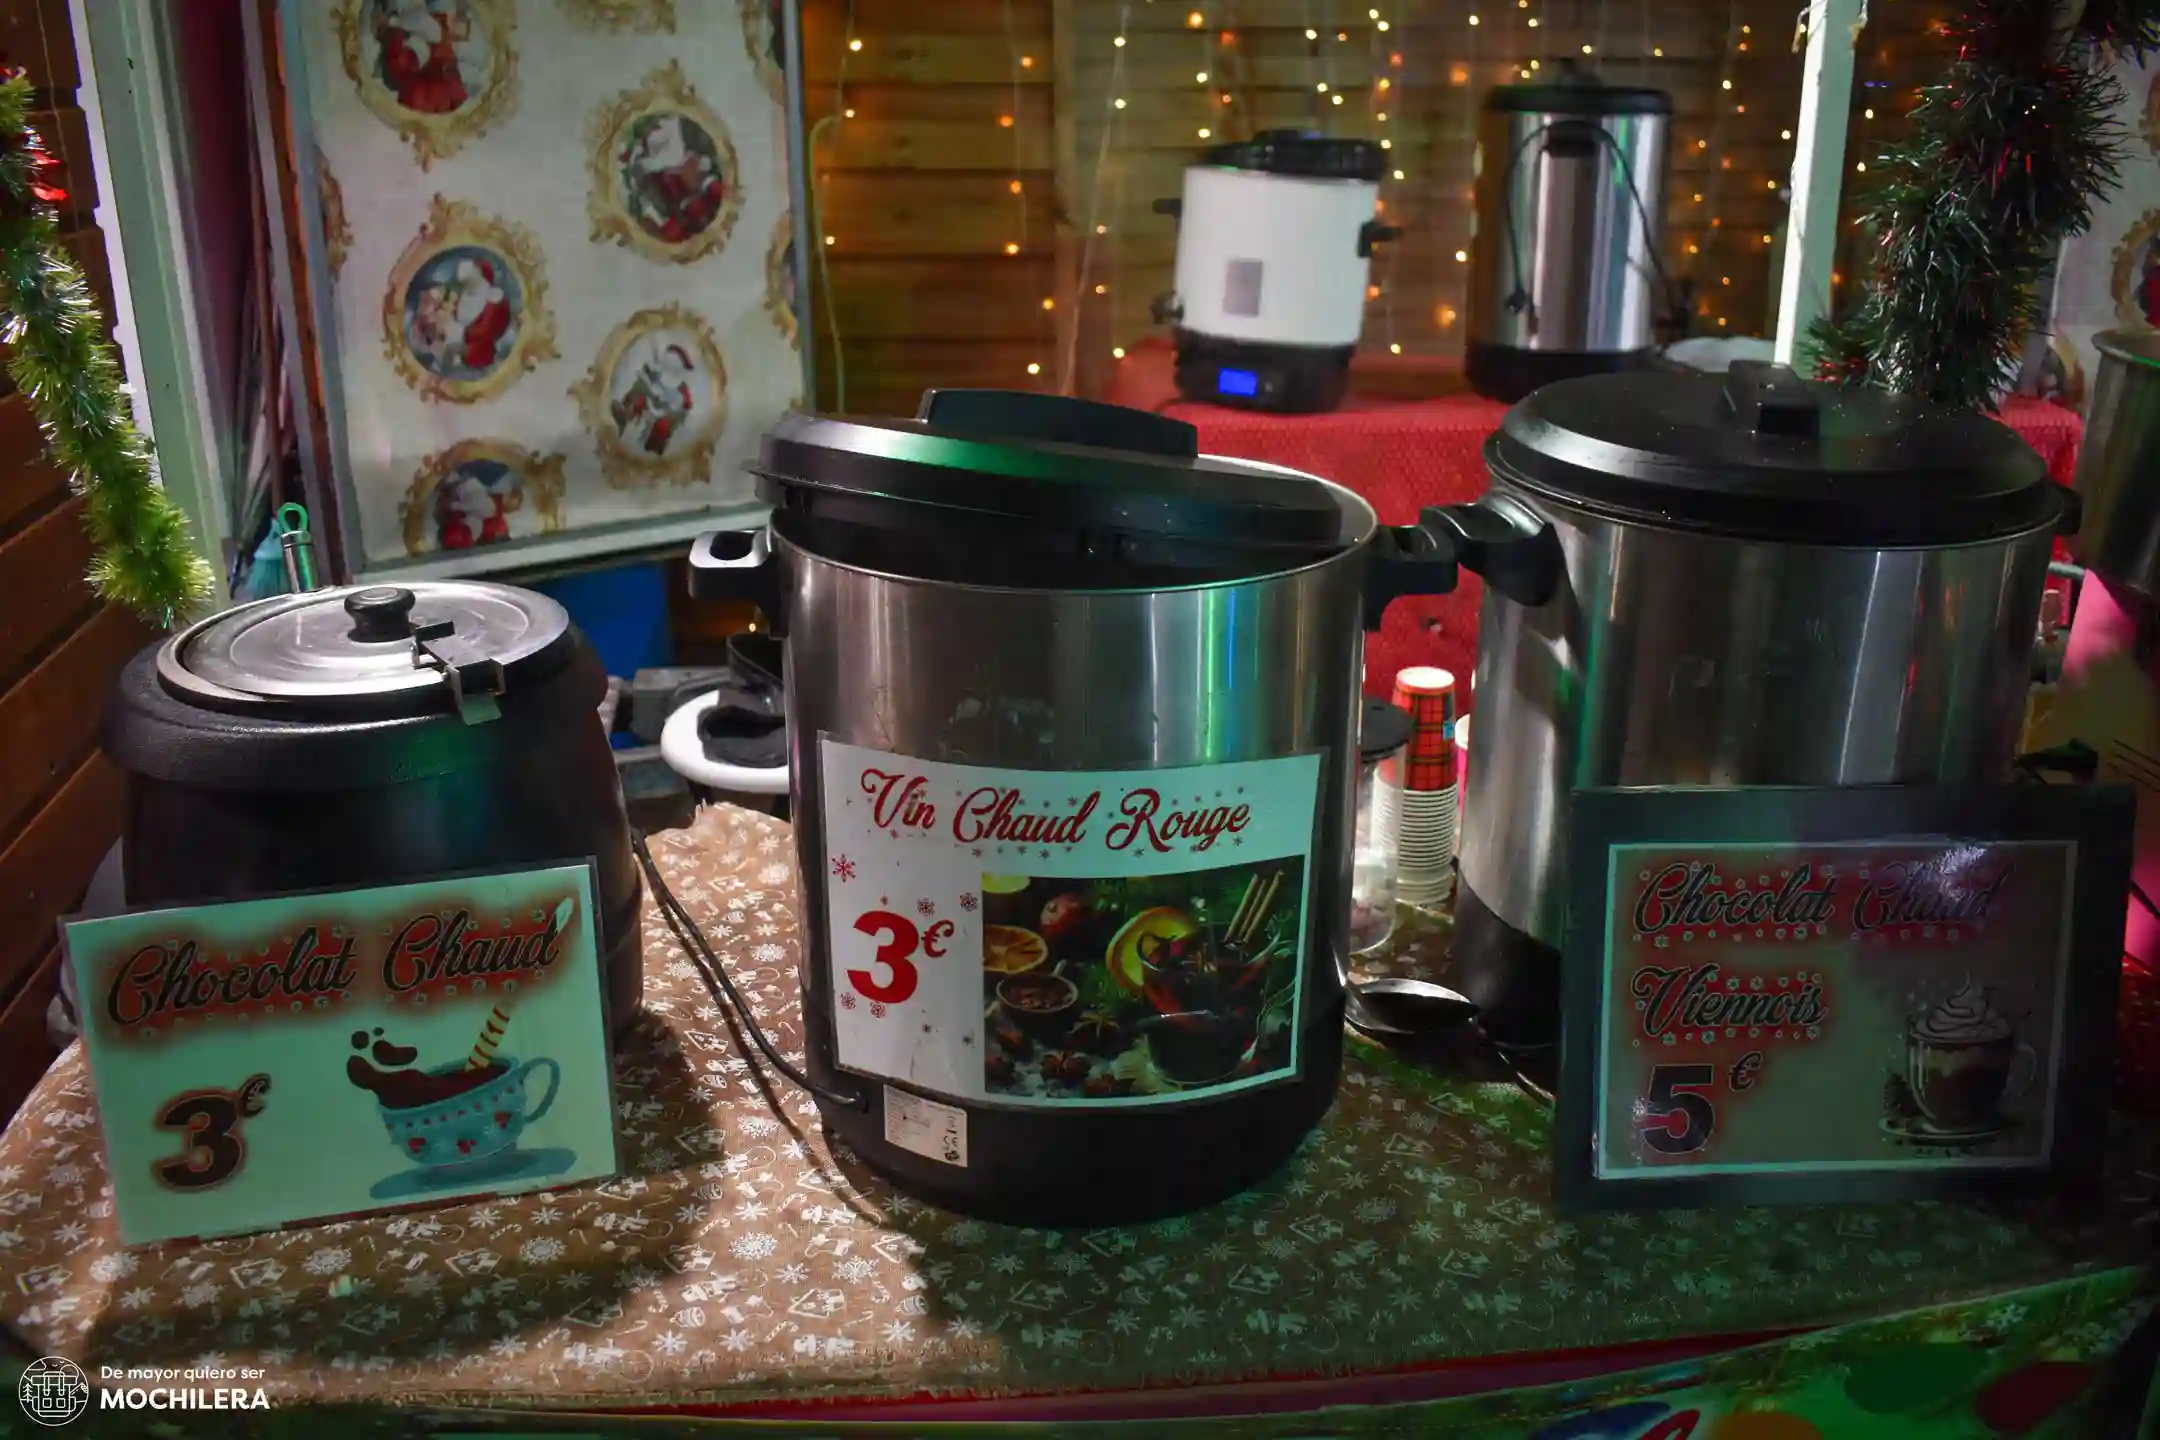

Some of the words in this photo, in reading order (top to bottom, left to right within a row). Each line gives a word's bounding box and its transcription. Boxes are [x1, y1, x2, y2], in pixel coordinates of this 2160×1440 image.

[861, 768, 936, 829] Vin
[953, 786, 1100, 844] Chaud
[1105, 788, 1252, 853] Rouge
[1633, 861, 1838, 934] Chocolat
[108, 925, 358, 1025] Chocolat
[383, 908, 562, 992] Chaud
[1630, 963, 1829, 1036] Viennois
